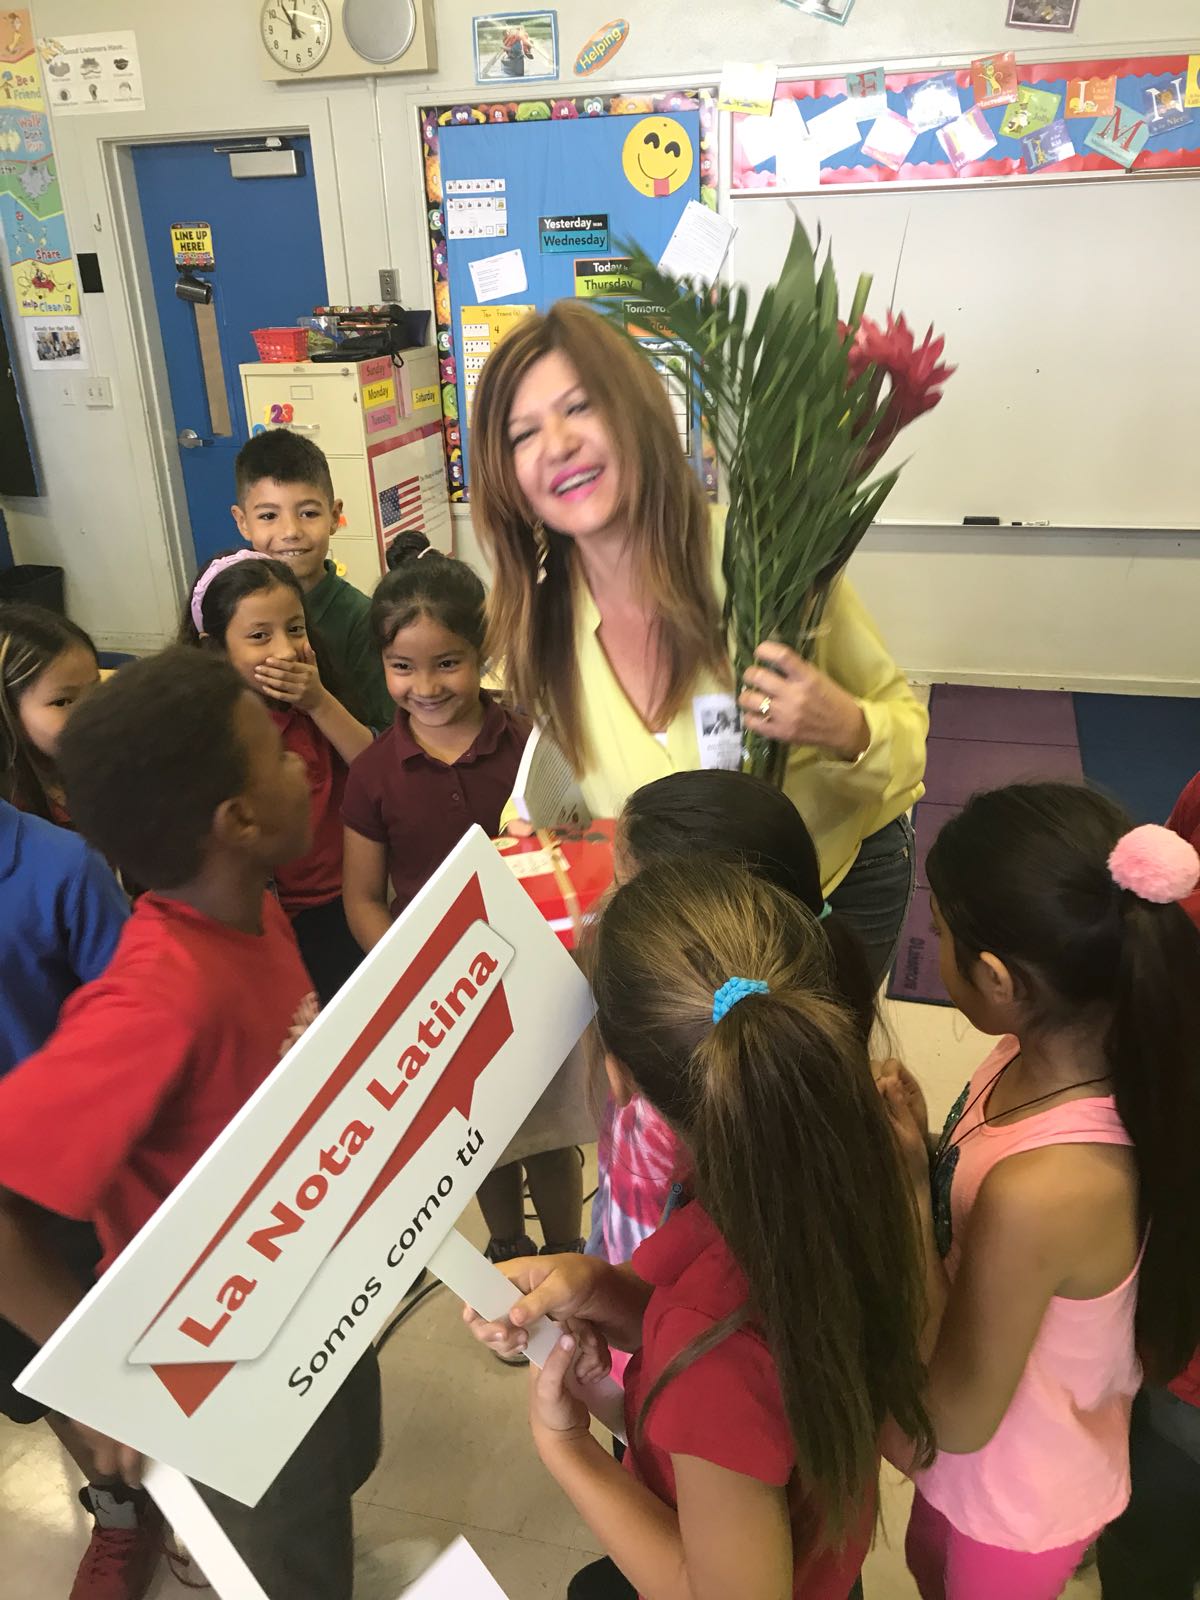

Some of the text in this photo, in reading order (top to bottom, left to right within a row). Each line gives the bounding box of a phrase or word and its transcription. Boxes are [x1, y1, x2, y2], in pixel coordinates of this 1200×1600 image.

[268, 25, 274, 35] 9
[274, 40, 279, 50] 8
[315, 36, 321, 46] 4
[307, 47, 313, 58] 5
[579, 27, 621, 69] Helping
[283, 49, 289, 60] 7
[296, 53, 302, 63] 6
[15, 75, 28, 86] Be
[1146, 78, 1183, 122] N
[1097, 105, 1145, 152] M
[544, 217, 592, 230] Yesterday
[174, 231, 208, 241] LINE UP
[544, 234, 606, 247] Wednesday
[180, 242, 205, 252] HERE!
[36, 250, 60, 260] Share
[593, 262, 622, 274] Today
[584, 279, 634, 292] Thursday
[39, 302, 64, 313] Clean
[625, 303, 669, 315] Tomorro
[368, 386, 389, 401] Monday
[177, 951, 498, 1347] La Nota Latina
[287, 1128, 484, 1395] Somos como tú
